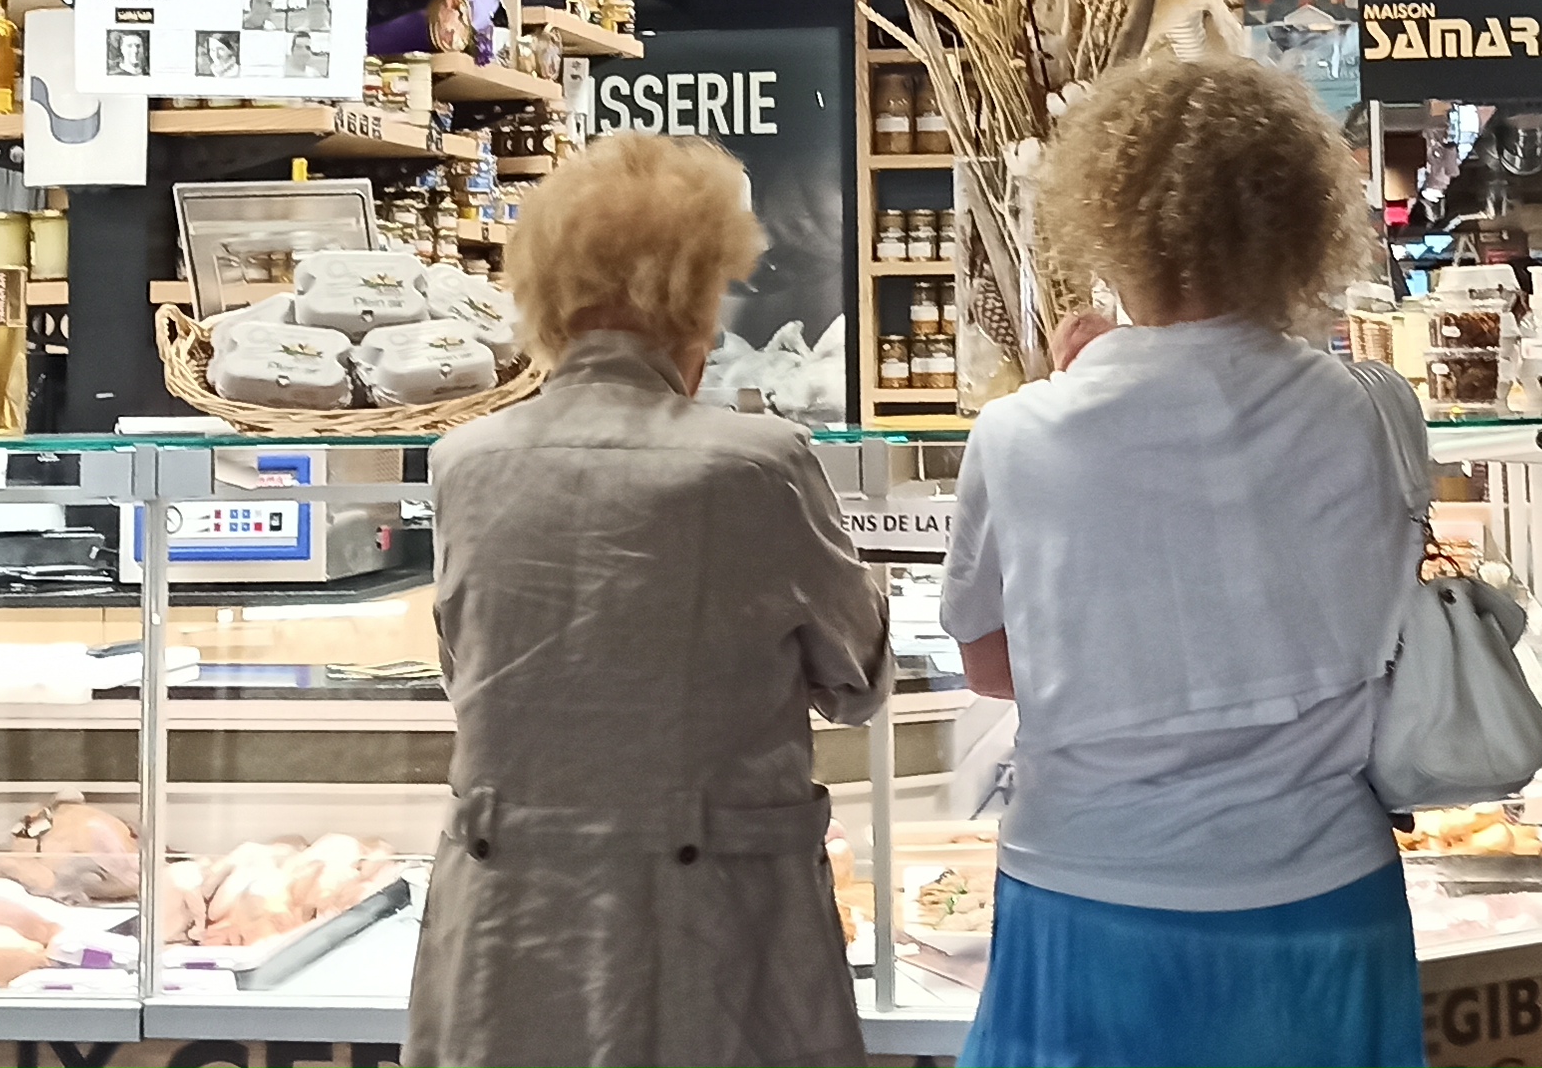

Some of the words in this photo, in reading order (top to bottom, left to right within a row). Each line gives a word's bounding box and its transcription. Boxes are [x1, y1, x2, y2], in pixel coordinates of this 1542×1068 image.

[1363, 1, 1436, 20] MAISON
[586, 70, 779, 136] ISSERIE
[840, 514, 878, 532] ENS
[883, 514, 909, 532] DE
[915, 514, 939, 532] LA
